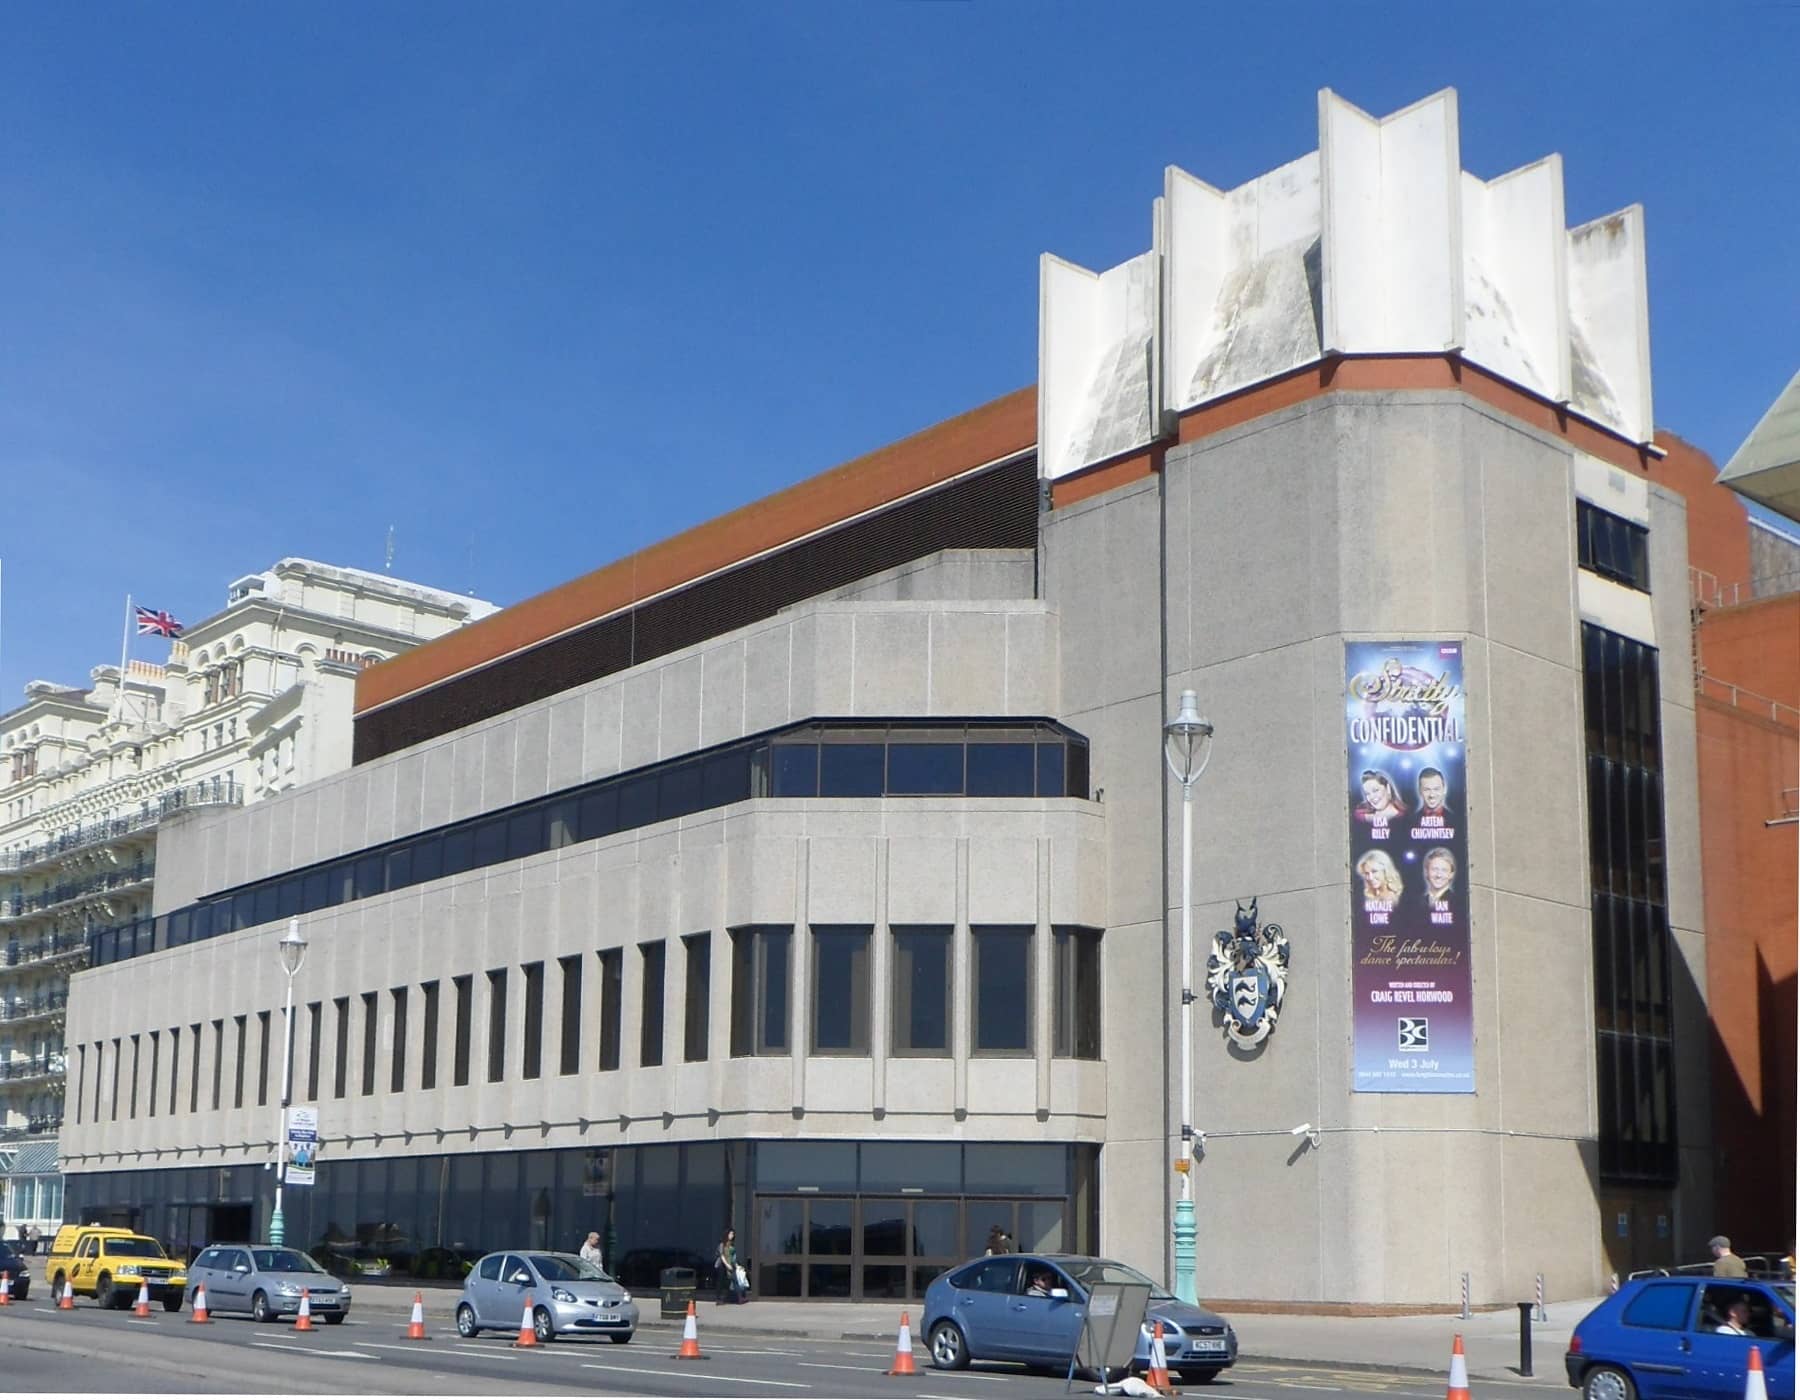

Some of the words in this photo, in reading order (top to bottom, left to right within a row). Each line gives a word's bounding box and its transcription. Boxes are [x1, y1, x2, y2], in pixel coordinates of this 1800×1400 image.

[1350, 658, 1461, 717] Strictly
[1351, 717, 1463, 744] CONFIDENTIAL
[1373, 816, 1388, 827] LISA
[1421, 816, 1444, 827] ARTEM
[1371, 828, 1390, 839] RILEY
[1411, 828, 1455, 839] CHIGVINTSEV
[1365, 901, 1393, 912] NATALIE
[1435, 901, 1448, 911] IAN
[1370, 913, 1389, 924] LOWE
[1431, 912, 1453, 924] WAITE
[1370, 935, 1397, 953] The
[1396, 938, 1451, 957] fabulous
[1360, 952, 1392, 965] dance
[1371, 991, 1392, 1002] CRAIG
[1394, 991, 1415, 1002] REVEL
[1416, 991, 1453, 1002] HORWOOD
[1388, 1059, 1409, 1069] Wed
[1411, 1059, 1417, 1069] 3
[1420, 1059, 1439, 1071] July
